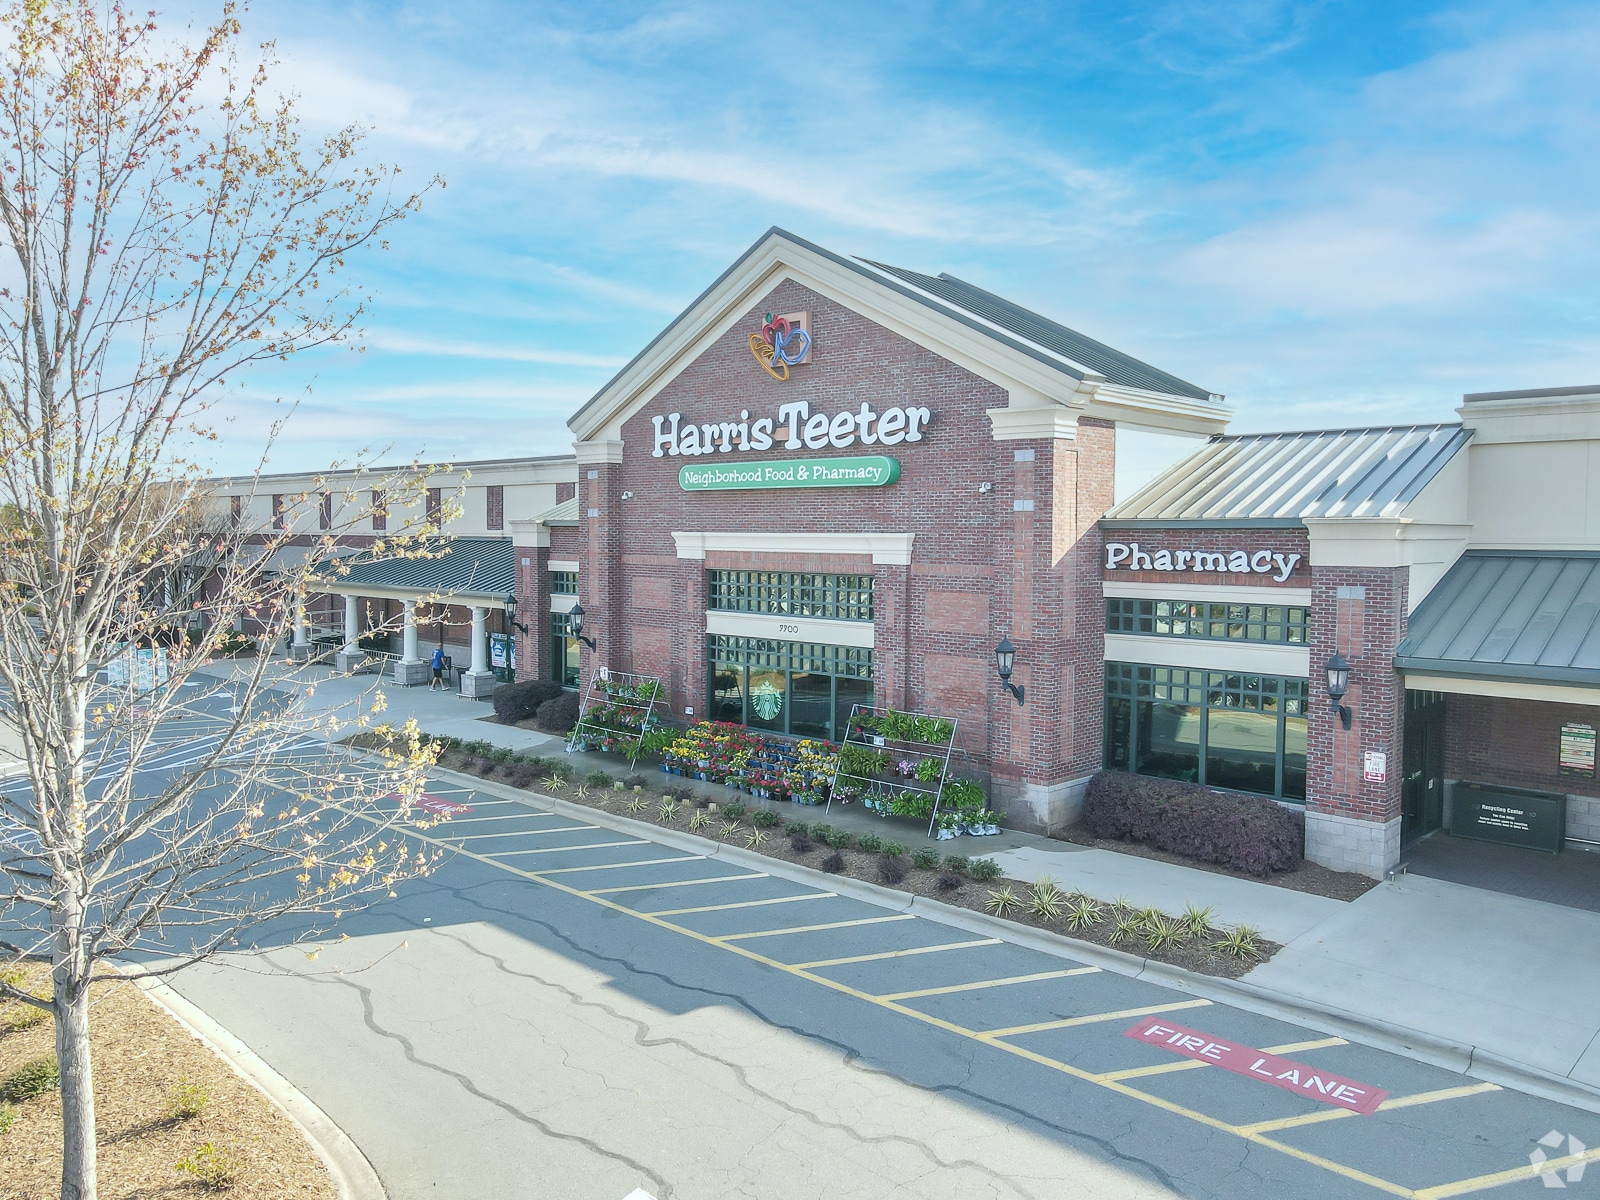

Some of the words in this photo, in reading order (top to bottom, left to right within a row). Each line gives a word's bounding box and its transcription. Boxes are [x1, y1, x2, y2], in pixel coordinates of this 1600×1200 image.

[651, 408, 774, 458] Harris
[778, 400, 931, 451] Teeter
[684, 467, 763, 488] Neighborhood
[764, 467, 795, 481] Food
[796, 465, 810, 480] &
[812, 465, 883, 482] Pharmacy
[1105, 542, 1301, 583] Pharmacy
[1482, 804, 1506, 813] Recycling
[1144, 1025, 1232, 1060] FIRE
[1249, 1058, 1366, 1104] LANE
